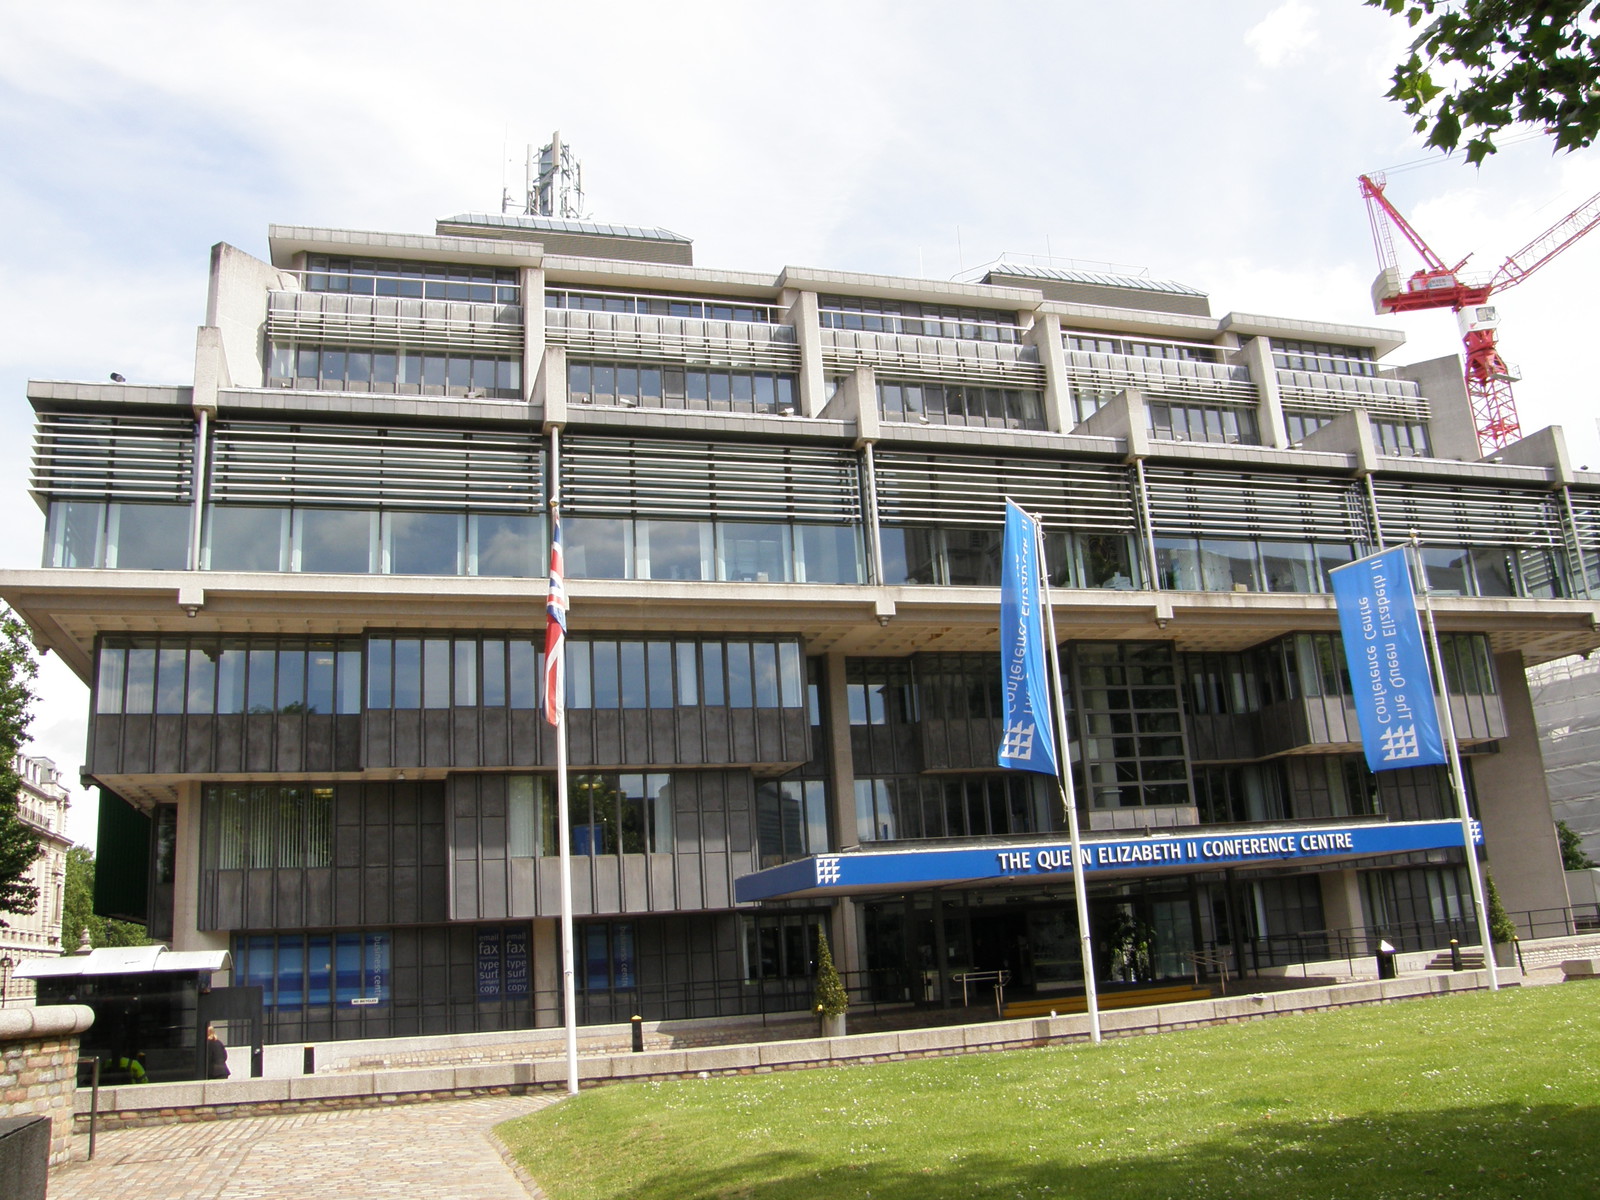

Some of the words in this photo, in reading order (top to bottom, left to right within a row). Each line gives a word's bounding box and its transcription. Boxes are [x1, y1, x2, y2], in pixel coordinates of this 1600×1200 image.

[998, 851, 1032, 870] THE
[1037, 848, 1092, 870] QUEN
[1098, 843, 1181, 864] ELIZABETH
[1187, 842, 1197, 858] II
[1202, 836, 1296, 857] CONFERENCE
[1301, 833, 1353, 850] CENTRE
[479, 933, 499, 941] email
[506, 932, 526, 940] email
[479, 941, 499, 955] fax
[506, 940, 526, 953] fax
[374, 935, 382, 973] business
[479, 961, 499, 970] type
[507, 960, 527, 969] type
[479, 968, 499, 979] surf
[507, 967, 526, 977] surf
[479, 985, 500, 994] copy
[507, 984, 527, 993] copy
